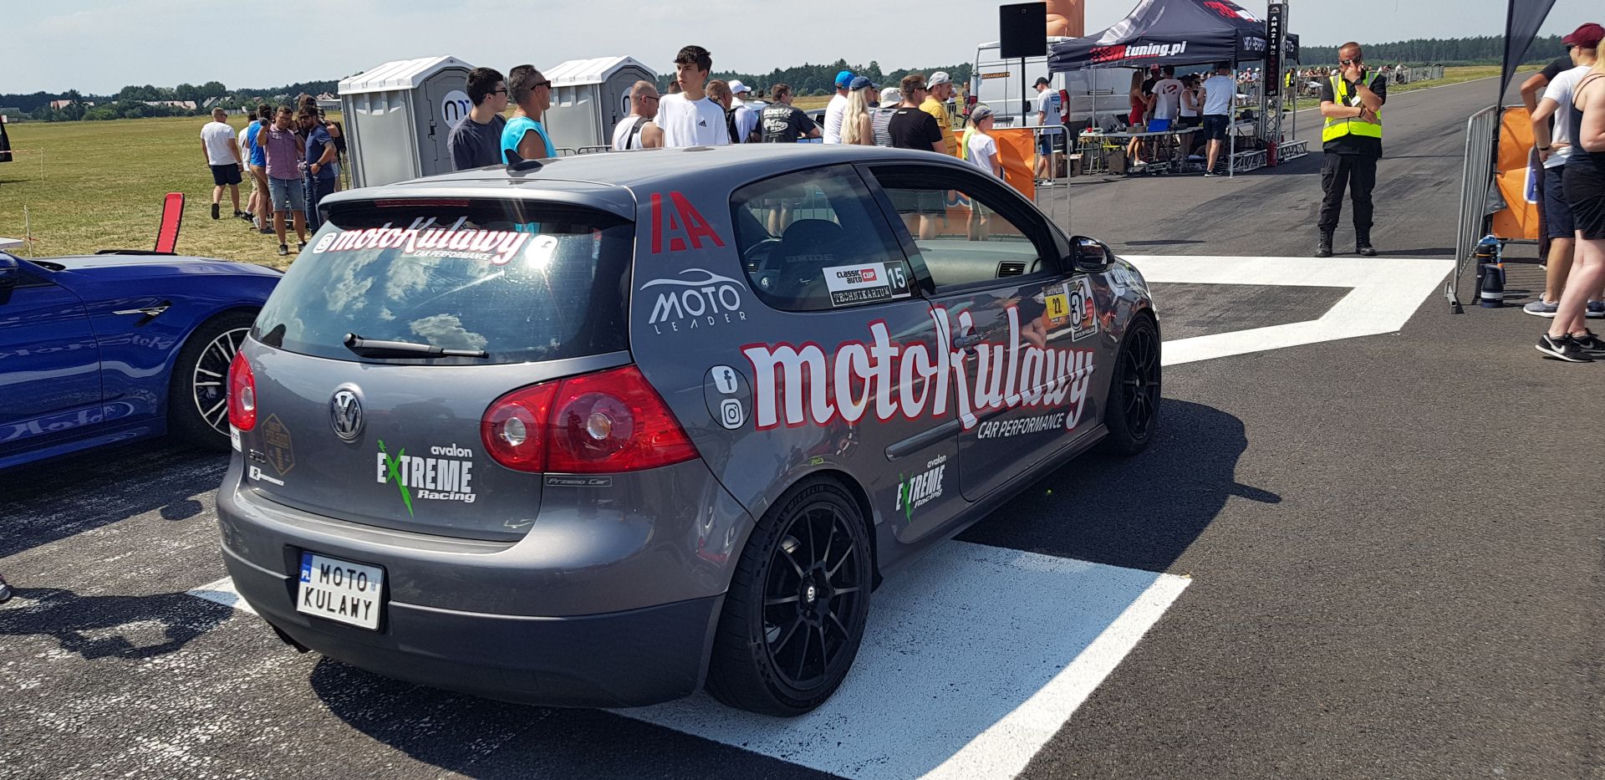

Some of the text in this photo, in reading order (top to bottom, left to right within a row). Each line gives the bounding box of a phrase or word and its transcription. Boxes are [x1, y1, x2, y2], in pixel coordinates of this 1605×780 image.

[1270, 16, 1278, 56] AMAZING
[887, 267, 906, 290] 15
[649, 285, 741, 324] MOTO
[1053, 297, 1063, 315] 22
[1070, 282, 1087, 330] 31
[654, 311, 746, 335] LEADER
[740, 304, 1095, 431] motoKulawy
[977, 412, 1065, 439] CAR PERFORMANCE
[431, 444, 472, 458] avalon
[927, 454, 947, 468] avalon
[377, 446, 472, 505] EXTREME
[417, 489, 476, 503] Racing
[896, 464, 946, 518] EXTREME
[320, 563, 367, 592] MOTO
[304, 586, 372, 620] KULAWY
